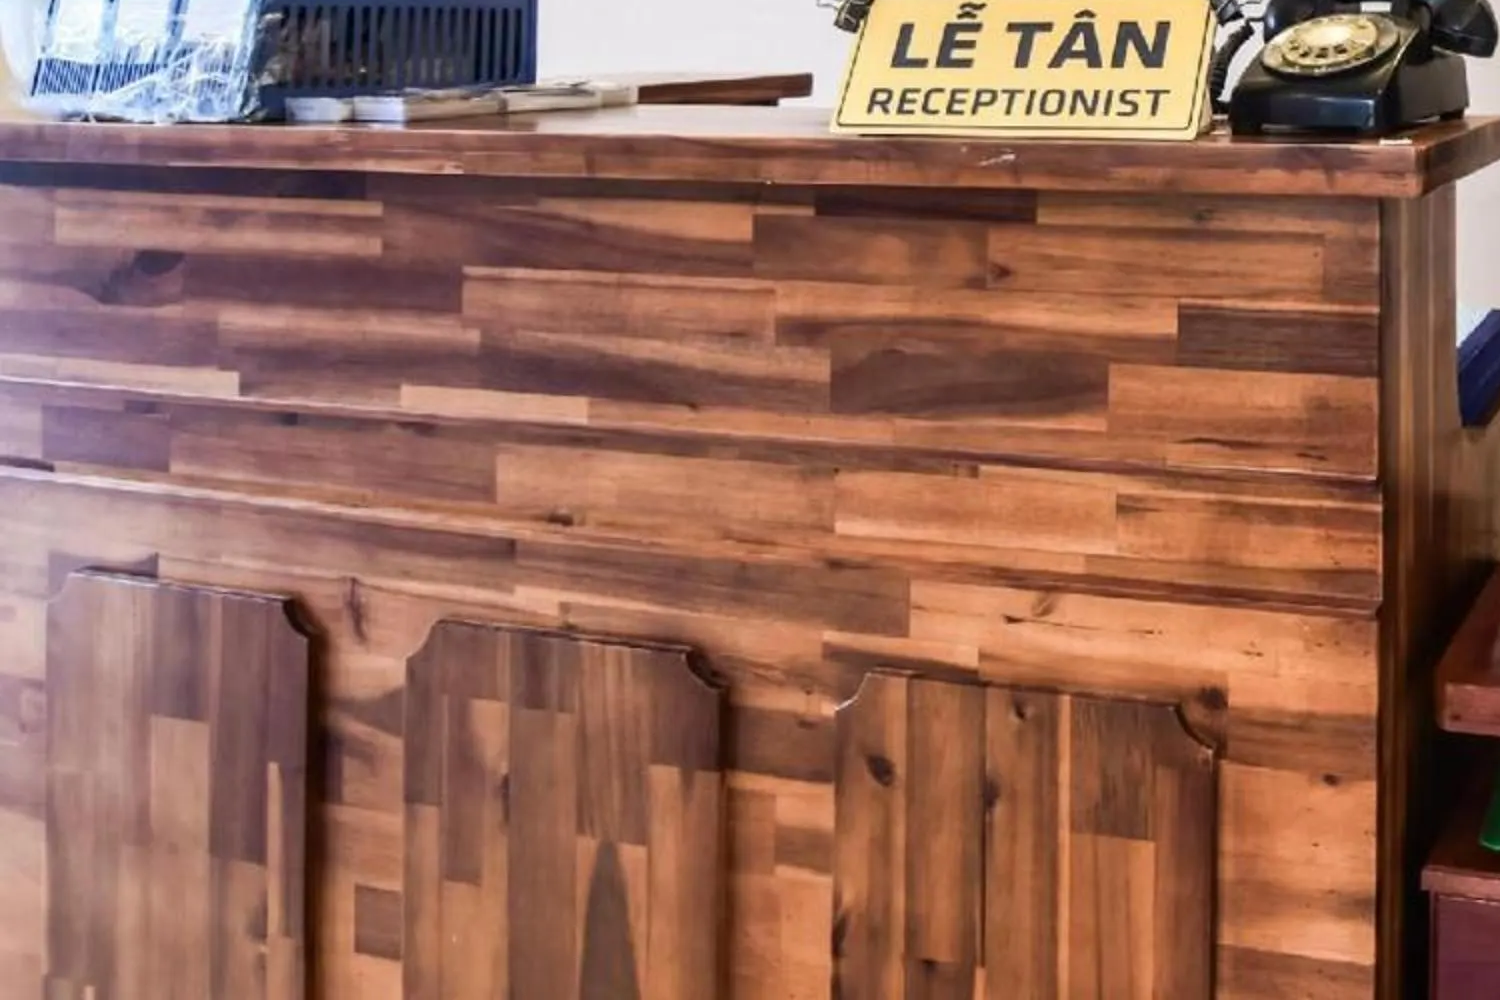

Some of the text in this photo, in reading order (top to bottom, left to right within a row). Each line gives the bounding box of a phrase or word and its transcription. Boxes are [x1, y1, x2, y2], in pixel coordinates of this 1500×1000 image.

[890, 2, 1171, 69] LỄ TÂN
[866, 86, 1171, 118] RECEPTIONIST
